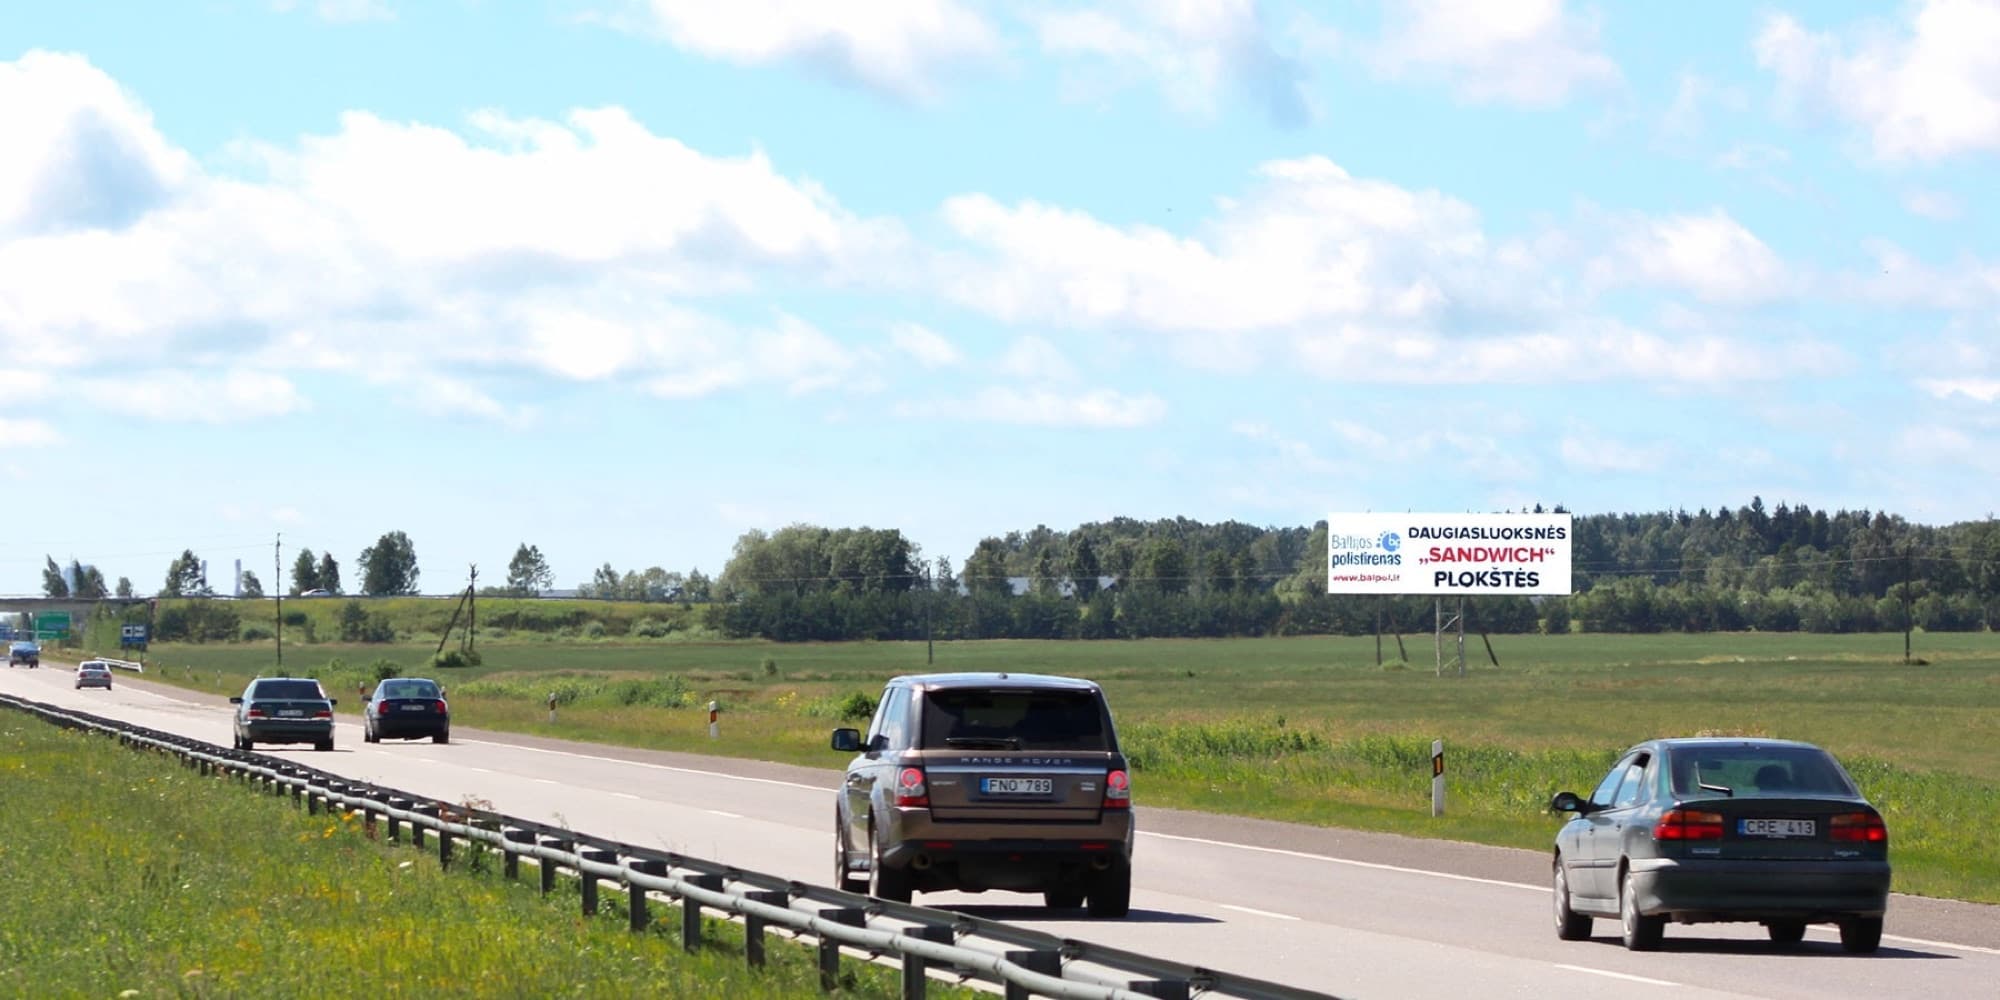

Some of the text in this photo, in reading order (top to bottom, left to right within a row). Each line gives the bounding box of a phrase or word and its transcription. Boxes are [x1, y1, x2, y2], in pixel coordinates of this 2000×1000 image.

[1408, 525, 1566, 540] DAUGIASLUOKSNĖS
[1331, 551, 1402, 568] polistirenas
[1332, 573, 1400, 583] www.balpol.lt
[1434, 567, 1540, 588] PLOKŠTĖS
[989, 779, 1051, 792] FNO 789
[1746, 820, 1813, 834] CRE 413
